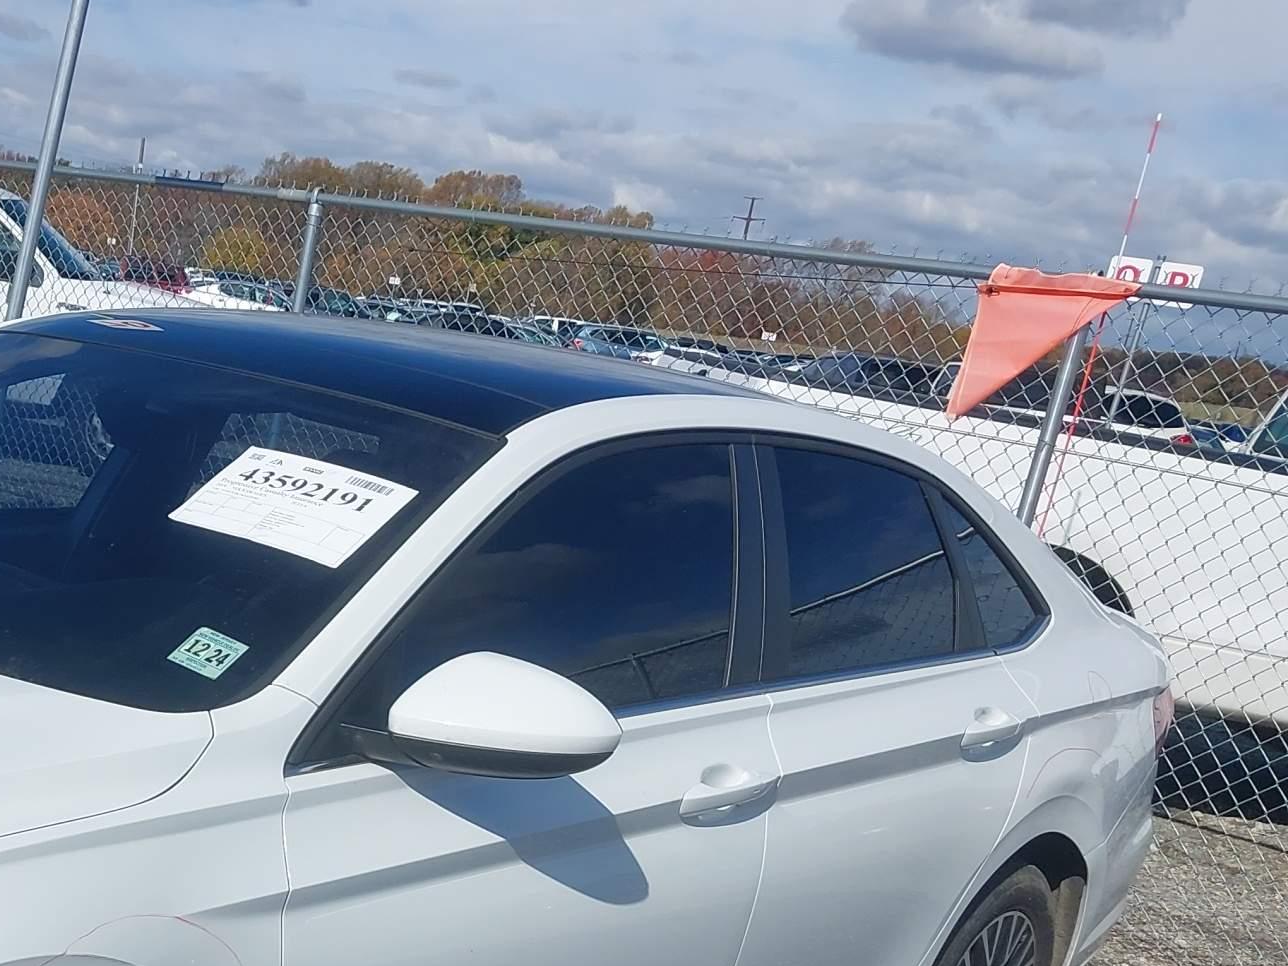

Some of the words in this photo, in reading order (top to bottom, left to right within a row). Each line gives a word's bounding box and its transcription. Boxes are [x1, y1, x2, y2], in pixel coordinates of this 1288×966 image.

[238, 467, 374, 512] 43592191
[183, 639, 212, 658] 12
[203, 648, 231, 667] 24
